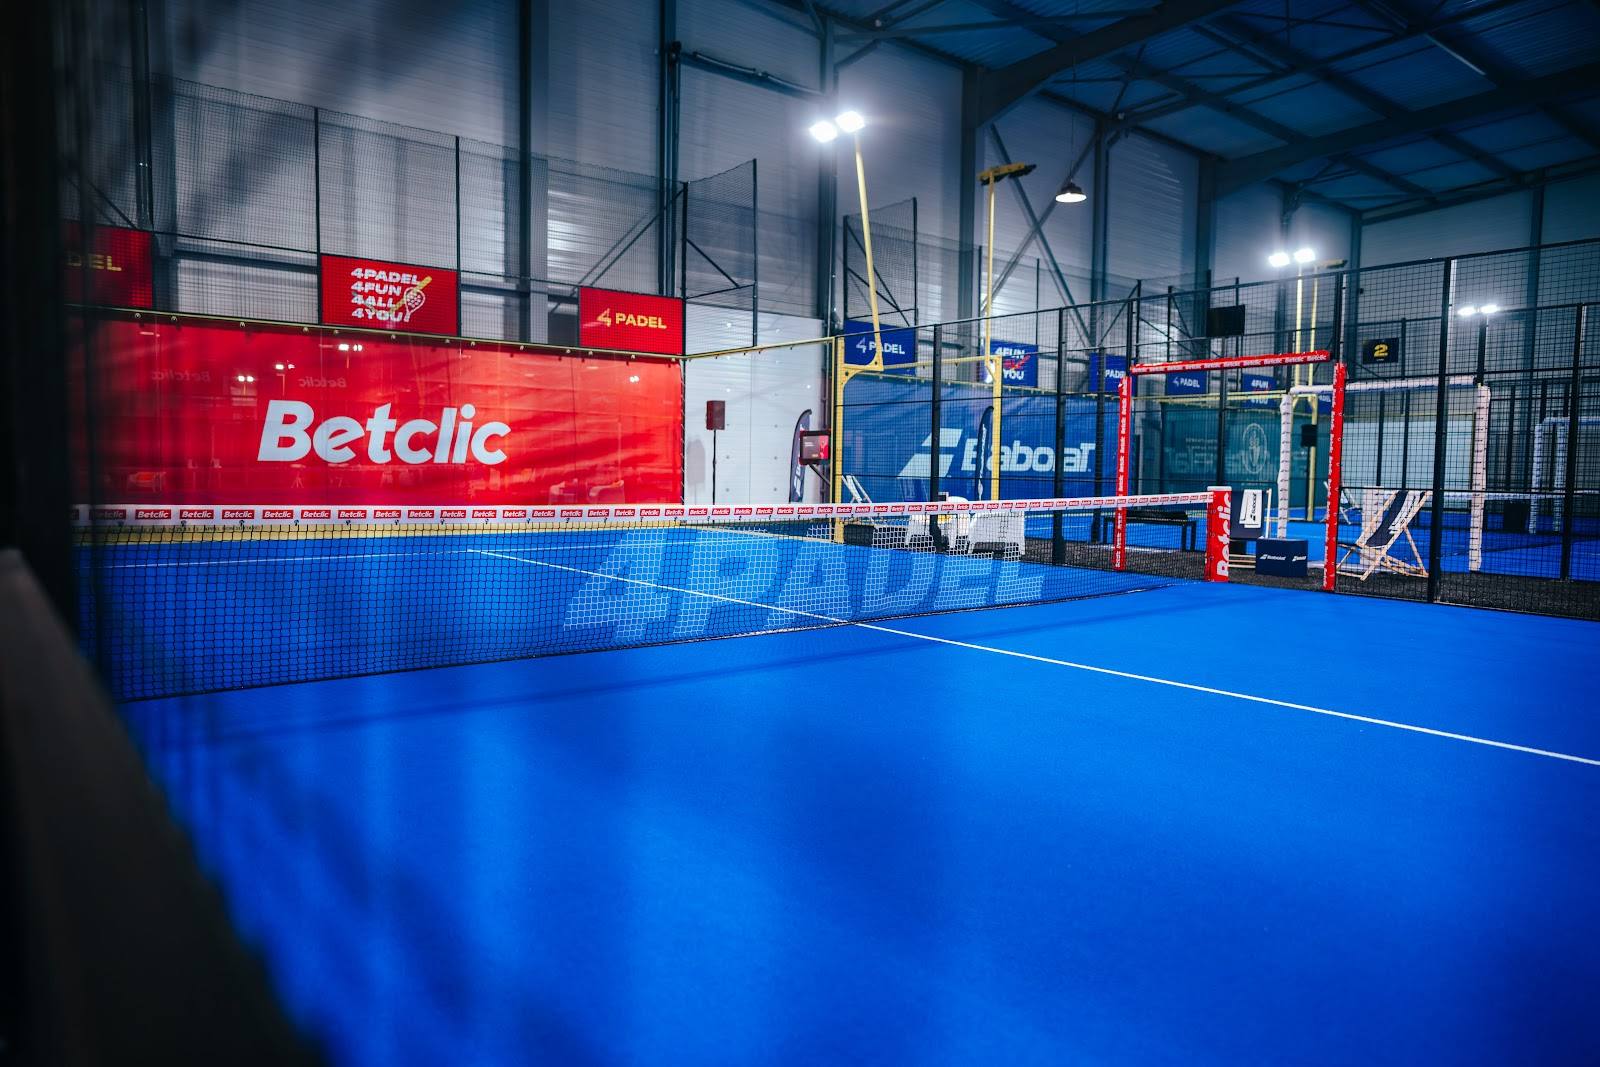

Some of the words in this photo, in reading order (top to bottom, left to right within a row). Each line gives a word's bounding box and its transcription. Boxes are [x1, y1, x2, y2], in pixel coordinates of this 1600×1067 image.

[351, 268, 421, 285] 4PADEL
[351, 281, 402, 296] 4FUN
[351, 294, 397, 308] 4ALL
[351, 308, 403, 321] 4YOU
[596, 308, 612, 327] 4
[615, 312, 667, 329] PADEL
[856, 337, 866, 353] 4
[1373, 343, 1389, 357] 2
[1003, 369, 1025, 380] YOU
[257, 399, 512, 464] Betclic
[409, 510, 433, 518] Betclic
